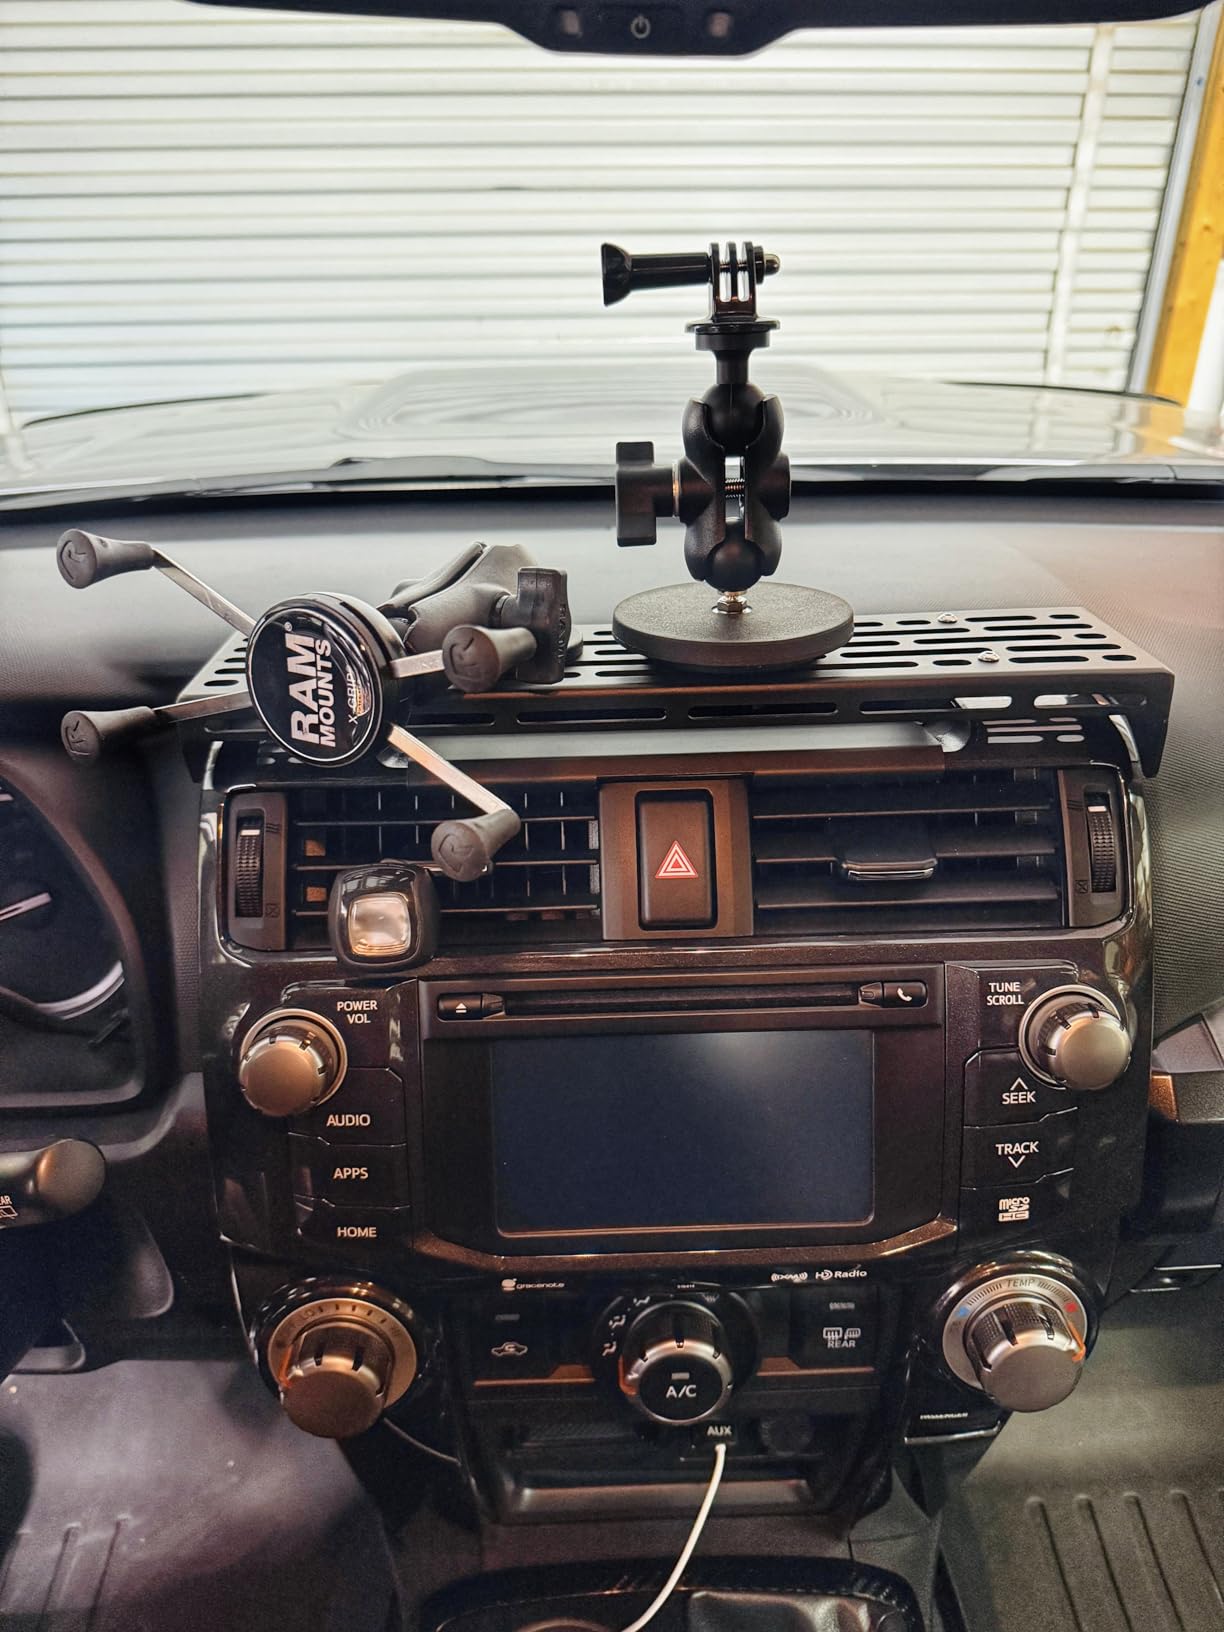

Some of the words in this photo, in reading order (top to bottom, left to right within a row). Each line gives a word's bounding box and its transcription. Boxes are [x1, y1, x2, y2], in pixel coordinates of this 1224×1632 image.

[284, 632, 320, 745] RAM
[315, 639, 336, 748] MOUNTS
[988, 982, 1021, 993] TUNE
[336, 1000, 378, 1012] POWER
[986, 994, 1024, 1006] SCROLL
[346, 1013, 371, 1024] VOL
[1001, 1091, 1036, 1105] SEEK
[326, 1113, 371, 1127] AUDIO
[995, 1141, 1039, 1156] TRACK
[333, 1167, 369, 1179] APPS
[336, 1226, 378, 1238] HOME
[834, 1269, 868, 1279] Radio
[1005, 1279, 1036, 1288] TEMP
[827, 1339, 856, 1348] REAR
[665, 1384, 697, 1399] A/C
[707, 1425, 732, 1436] AUX
